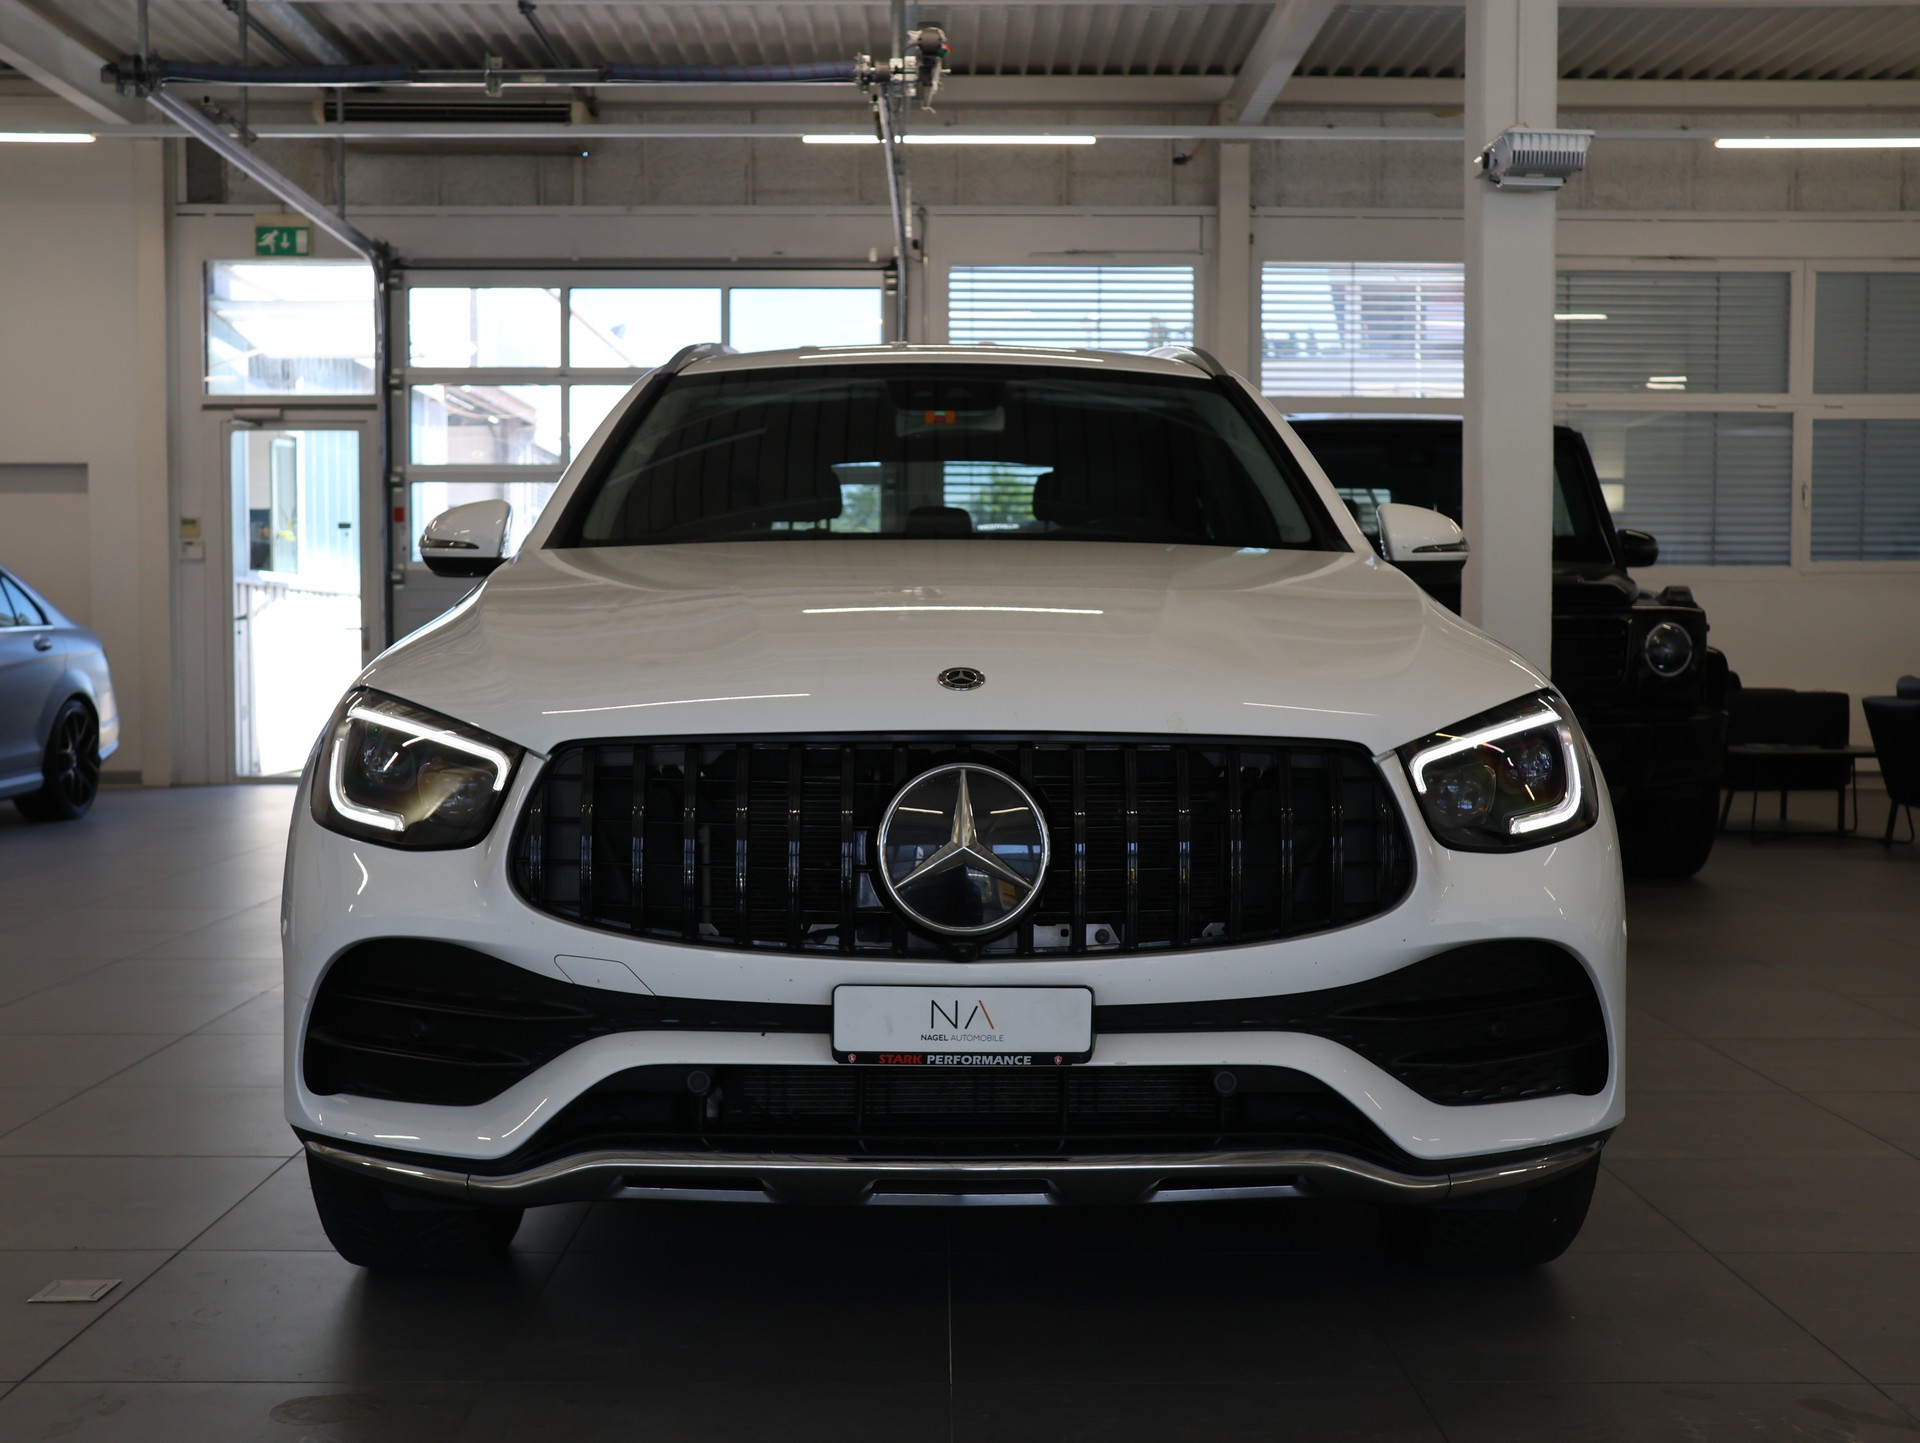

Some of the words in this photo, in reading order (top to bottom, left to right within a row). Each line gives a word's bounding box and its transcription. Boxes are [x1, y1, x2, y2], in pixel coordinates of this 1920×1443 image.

[920, 1034, 949, 1042] NAGEL
[950, 1034, 1005, 1042] AUTOMOBILE
[878, 1054, 922, 1065] STARK
[926, 1055, 1032, 1066] PERFORMANCE
